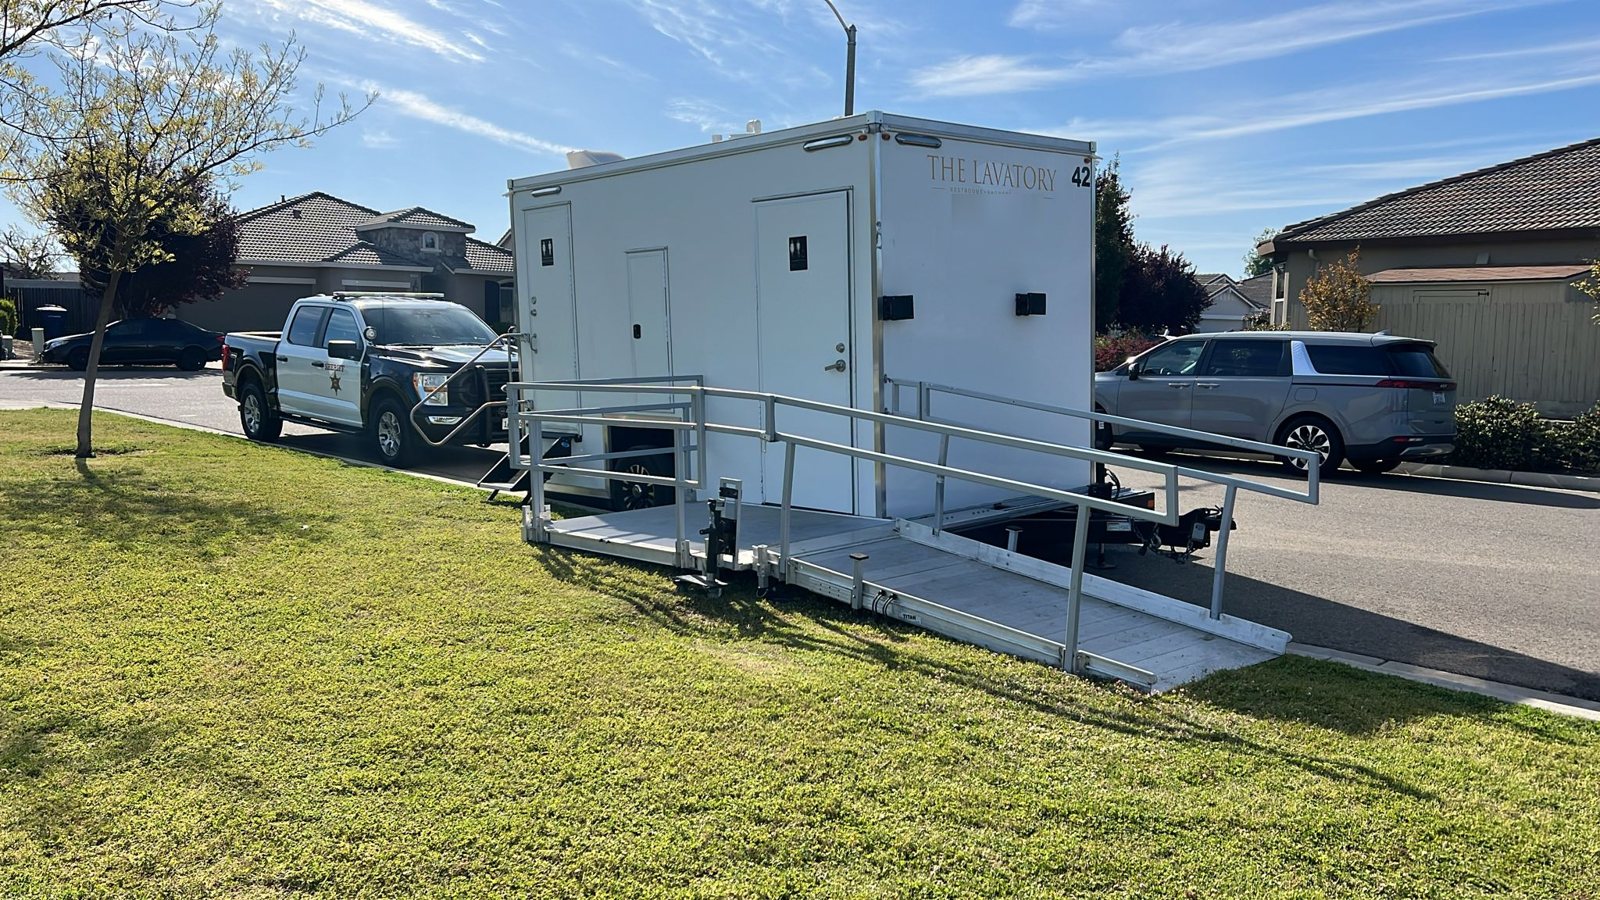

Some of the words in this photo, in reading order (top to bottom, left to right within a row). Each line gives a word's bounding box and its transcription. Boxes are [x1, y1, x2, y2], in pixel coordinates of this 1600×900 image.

[927, 154, 966, 183] THE
[973, 160, 1057, 192] LAVATORY
[1071, 166, 1091, 188] 42
